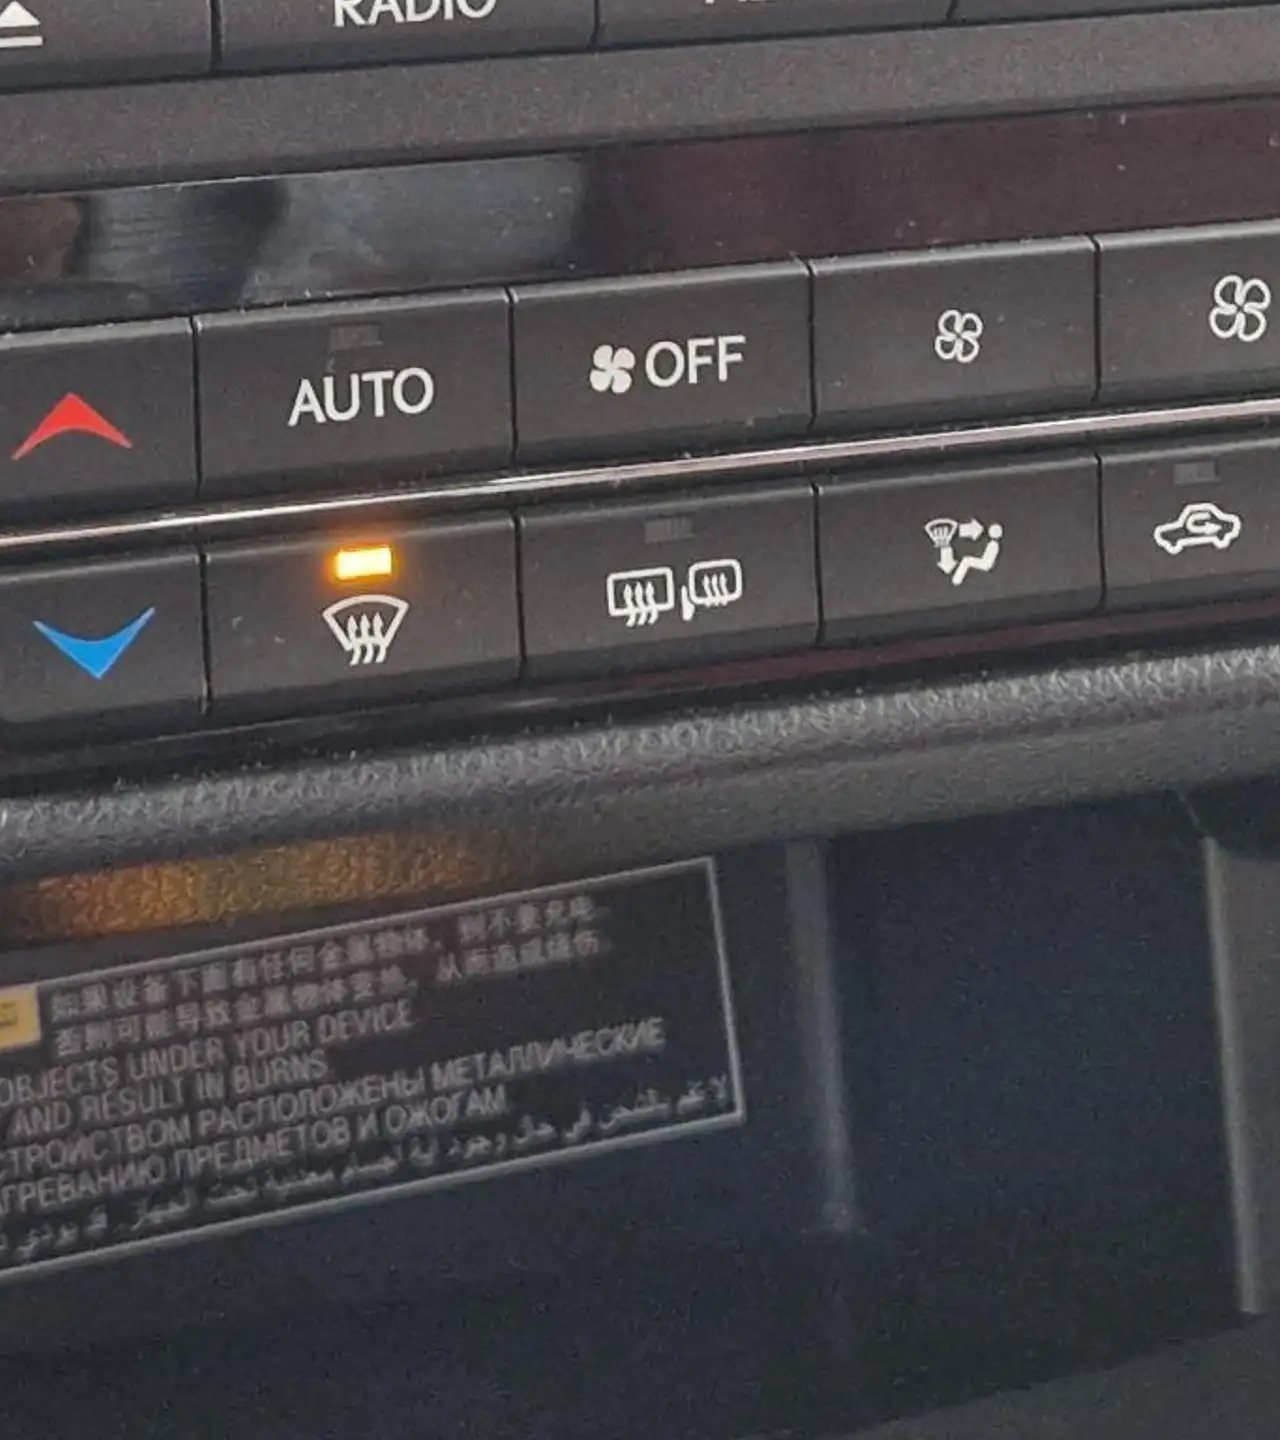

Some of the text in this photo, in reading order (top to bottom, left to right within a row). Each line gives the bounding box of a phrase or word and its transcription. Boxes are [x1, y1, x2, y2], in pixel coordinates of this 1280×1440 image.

[645, 334, 747, 389] OFF
[287, 366, 434, 427] AUTO
[128, 1037, 224, 1081] UNDER
[234, 1019, 309, 1058] YOUR
[11, 1101, 71, 1137] AND
[80, 1077, 183, 1121] RESULT
[195, 1071, 224, 1100] IN
[198, 1070, 424, 1134] РАСПОЛОЖЕНЫ
[173, 1117, 350, 1175] ПРЕДМЕТОВ
